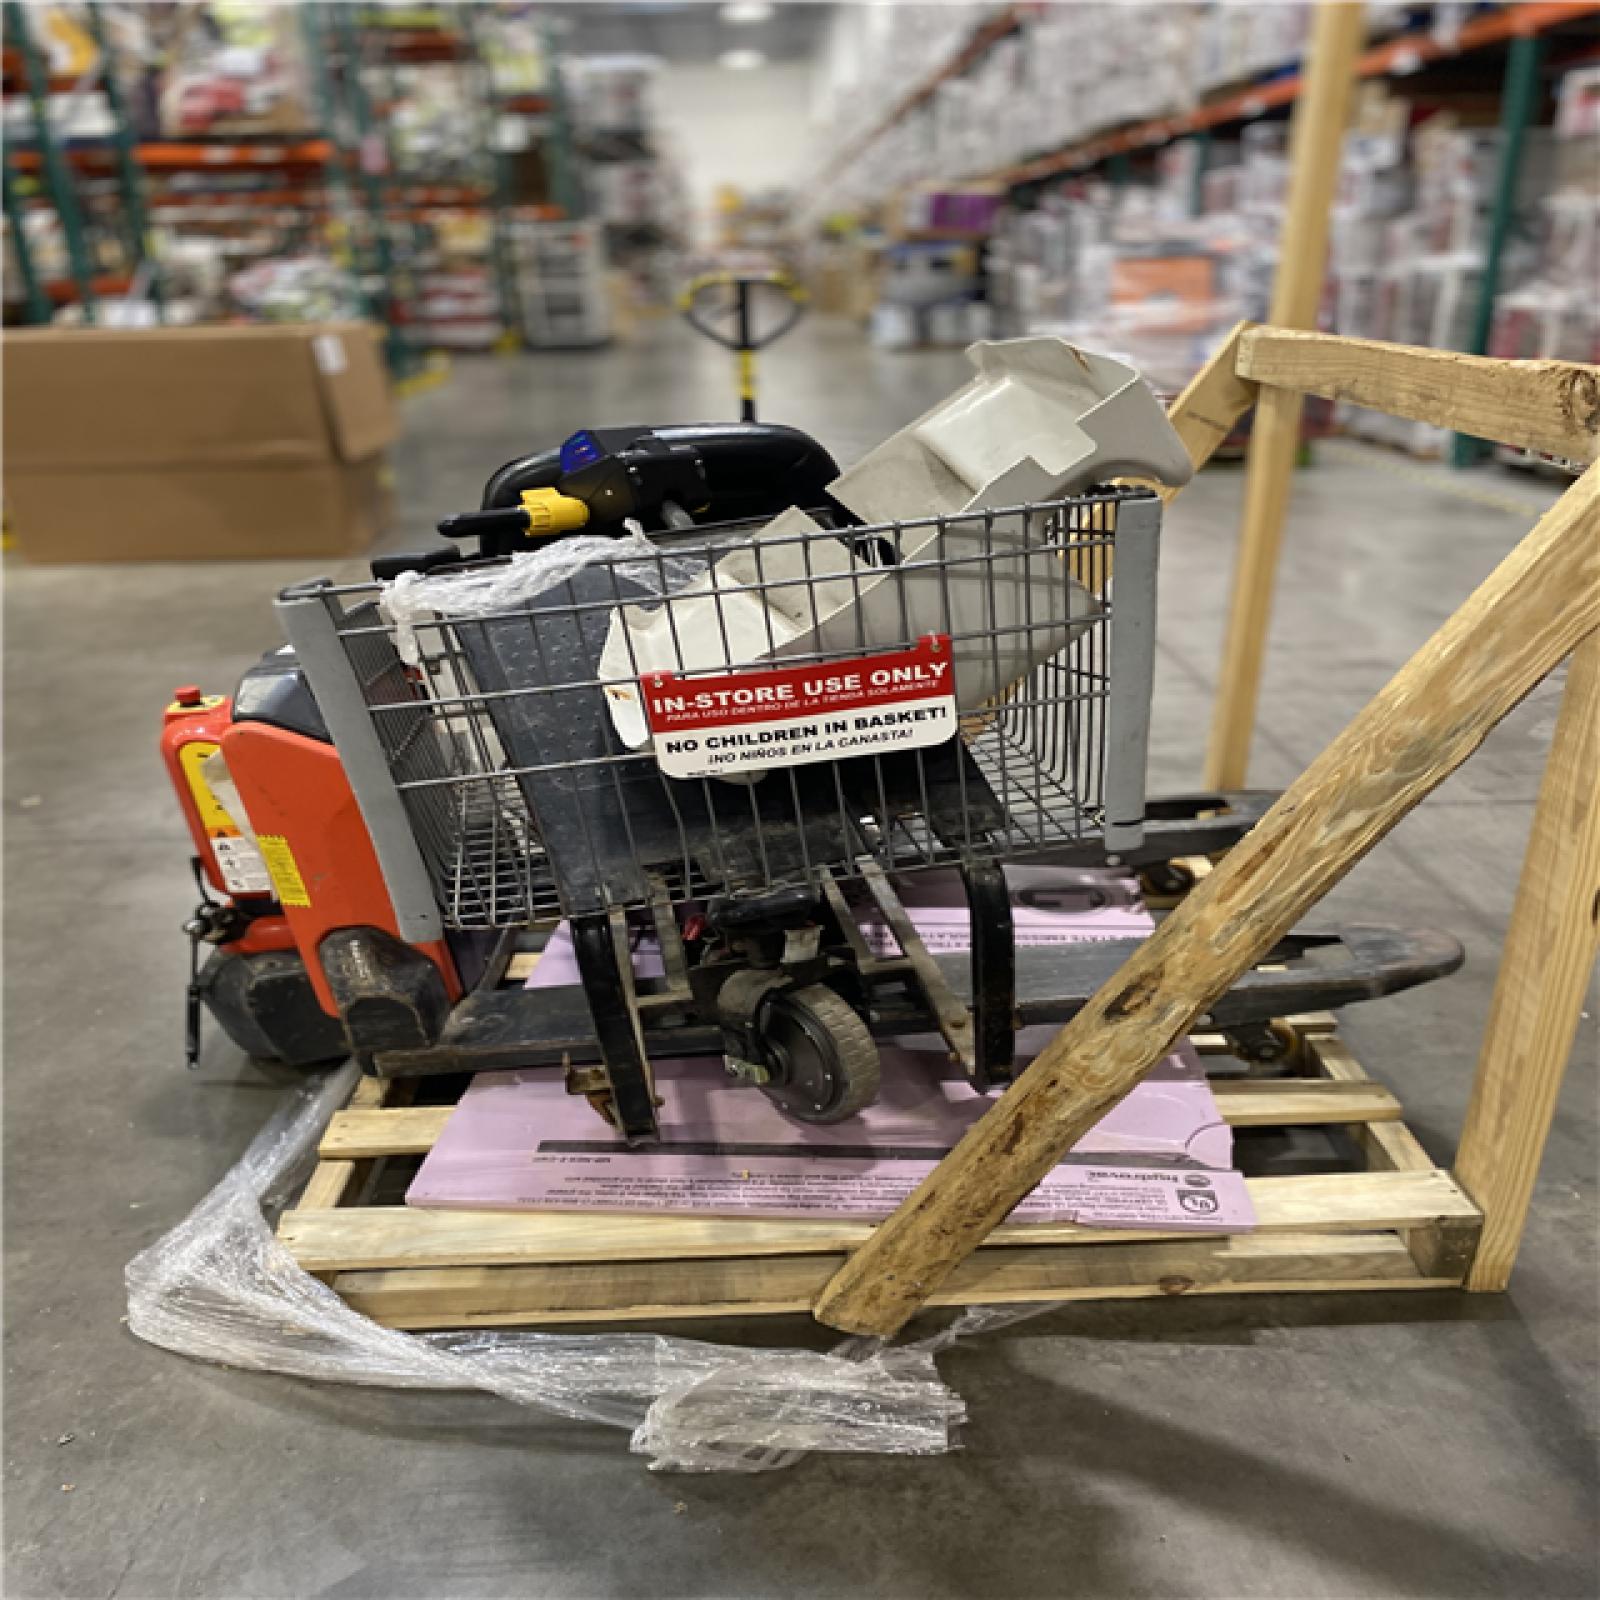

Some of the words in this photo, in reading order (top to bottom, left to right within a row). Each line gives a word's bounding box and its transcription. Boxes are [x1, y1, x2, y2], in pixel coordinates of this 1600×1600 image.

[652, 684, 795, 713] IN-STORE
[803, 674, 861, 696] USE
[871, 661, 948, 686] ONLY
[665, 739, 699, 754] NO
[705, 724, 818, 750] CHILDREN
[825, 719, 848, 735] IN
[854, 705, 947, 730] BASKET!
[792, 743, 811, 755] EN
[814, 739, 835, 751] LA
